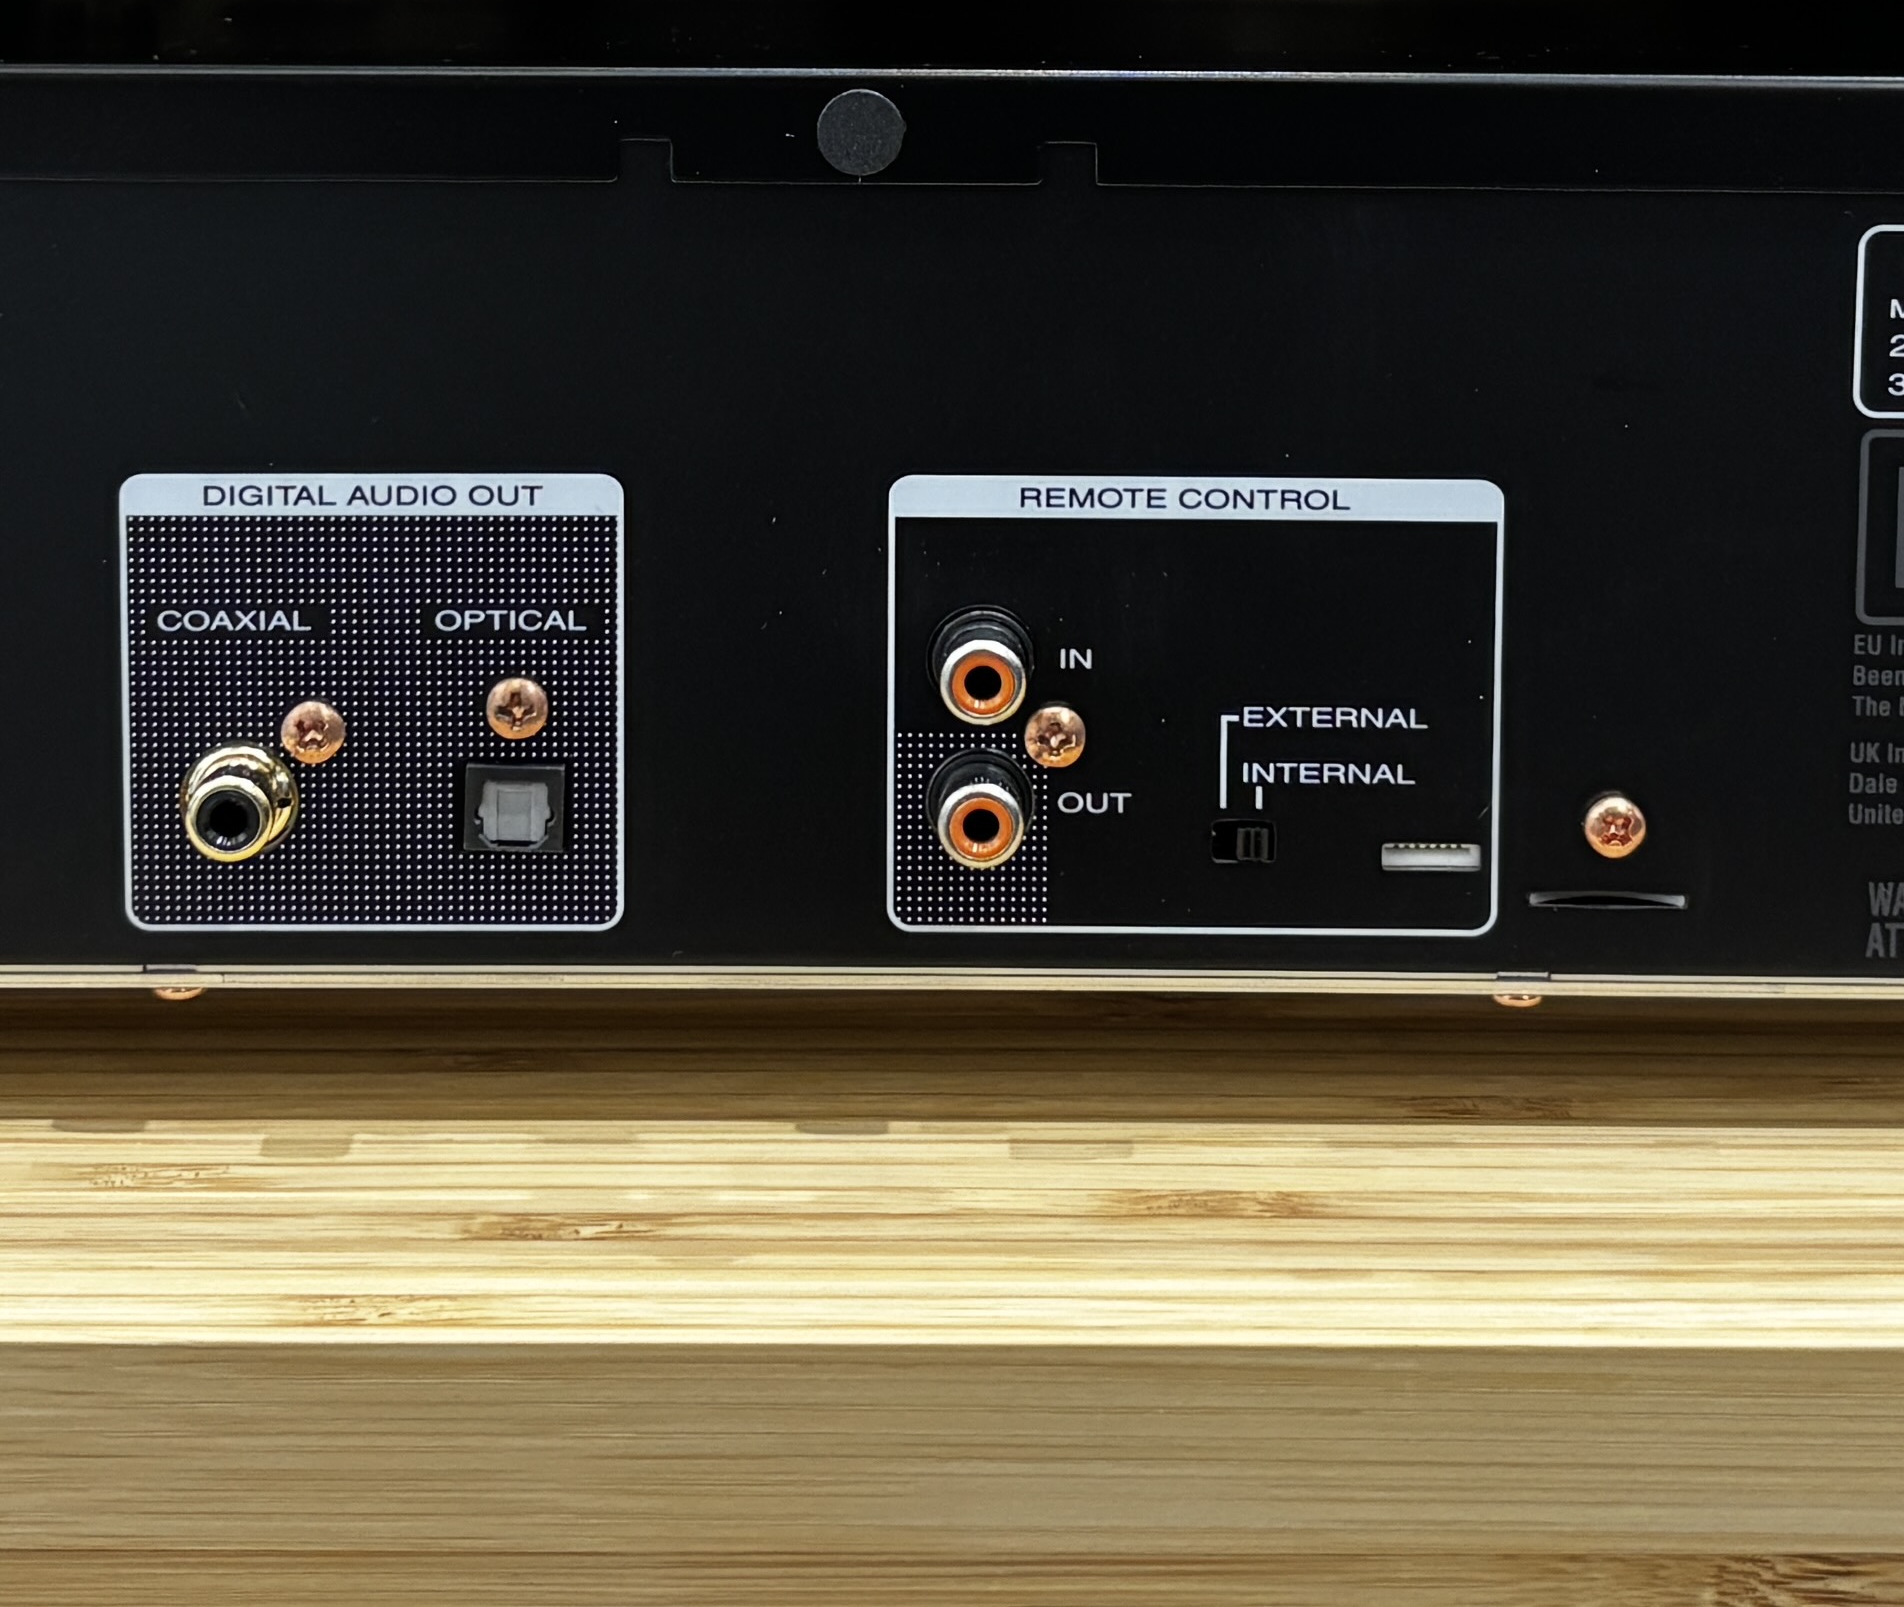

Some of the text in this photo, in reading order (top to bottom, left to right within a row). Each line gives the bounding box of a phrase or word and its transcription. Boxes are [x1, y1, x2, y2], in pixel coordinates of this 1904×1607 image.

[204, 485, 543, 506] DIGITAL AUDIO OUT
[1021, 488, 1350, 510] REMOTE CONTROL
[157, 610, 311, 631] COAXIAL
[435, 610, 586, 631] OPTICAL
[1854, 634, 1881, 655] EU
[1060, 649, 1092, 669] IN
[1852, 696, 1890, 716] The
[1243, 707, 1428, 728] EXTERNAL
[1851, 742, 1880, 763] UK
[1243, 763, 1415, 785] INTERNAL
[1849, 773, 1897, 794] Dale
[1058, 792, 1132, 813] OUT
